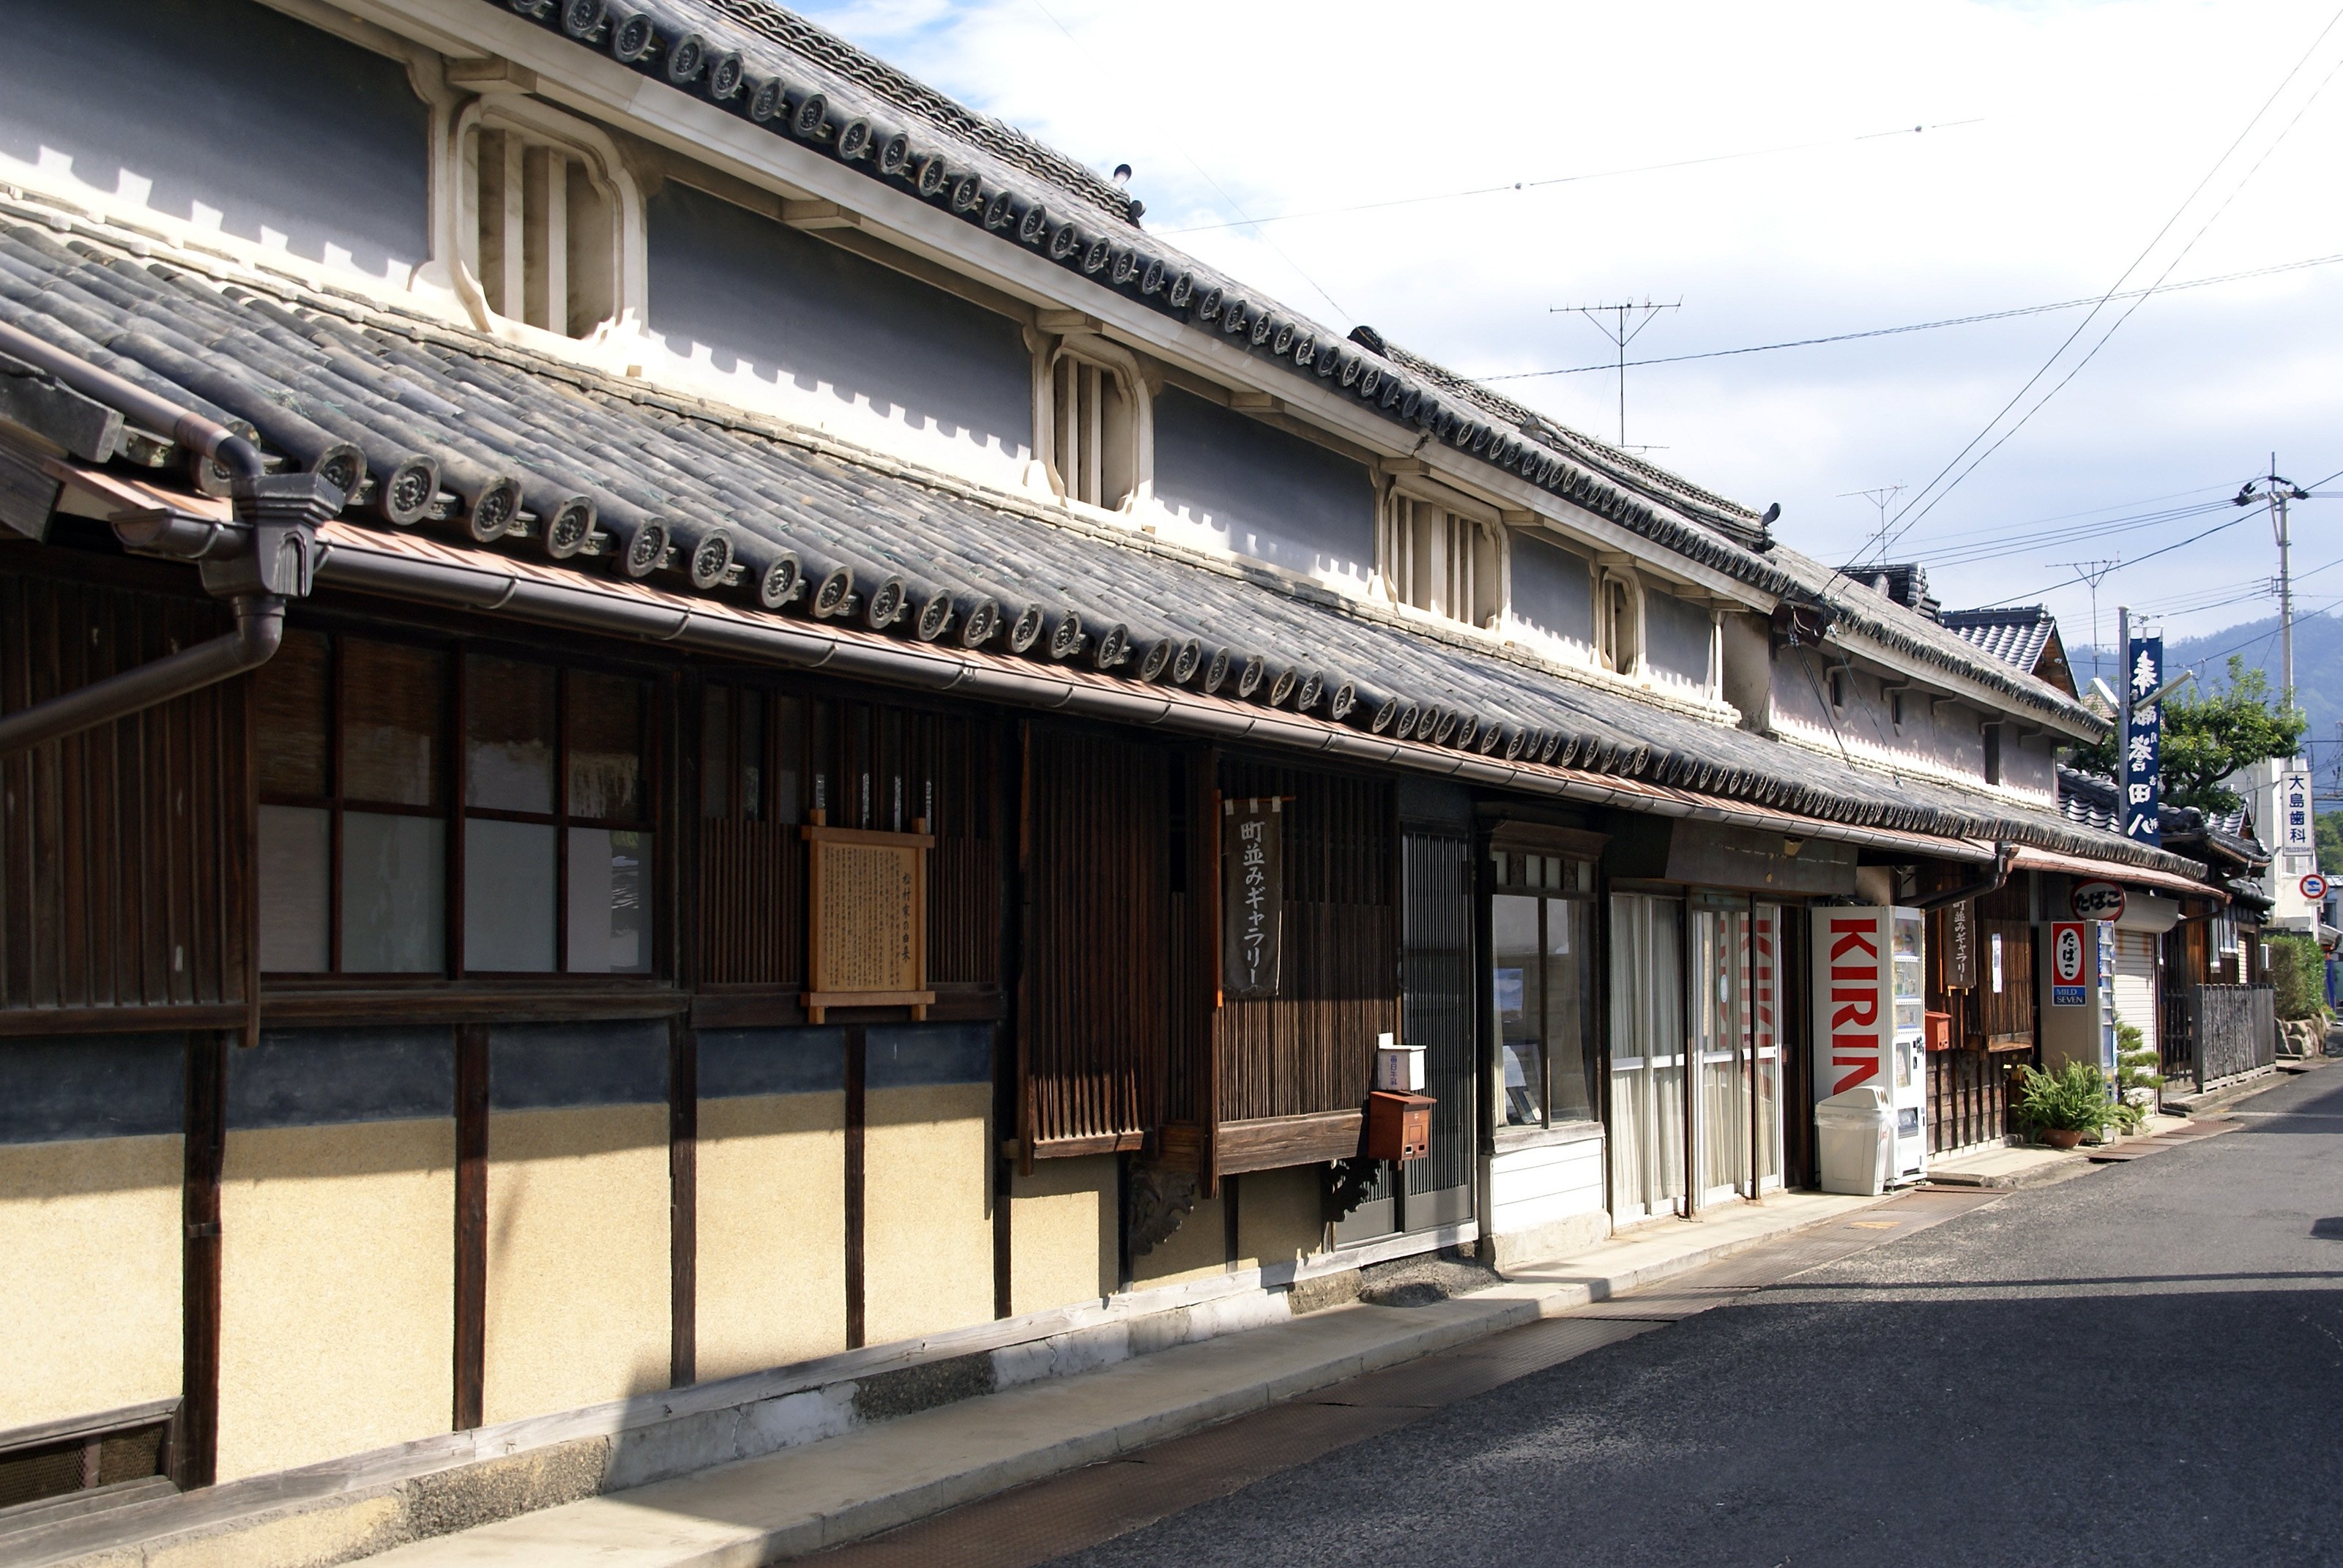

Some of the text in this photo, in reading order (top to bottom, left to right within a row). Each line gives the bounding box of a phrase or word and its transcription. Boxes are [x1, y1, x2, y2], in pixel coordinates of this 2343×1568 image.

[2289, 774, 2306, 843] 大島歯科
[1240, 820, 1265, 985] 町並みギャラリー
[2076, 890, 2121, 911] たばこ
[2063, 932, 2076, 977] たばこ
[1830, 919, 1879, 1096] KIRIN
[2057, 996, 2083, 1004] SEVEN
